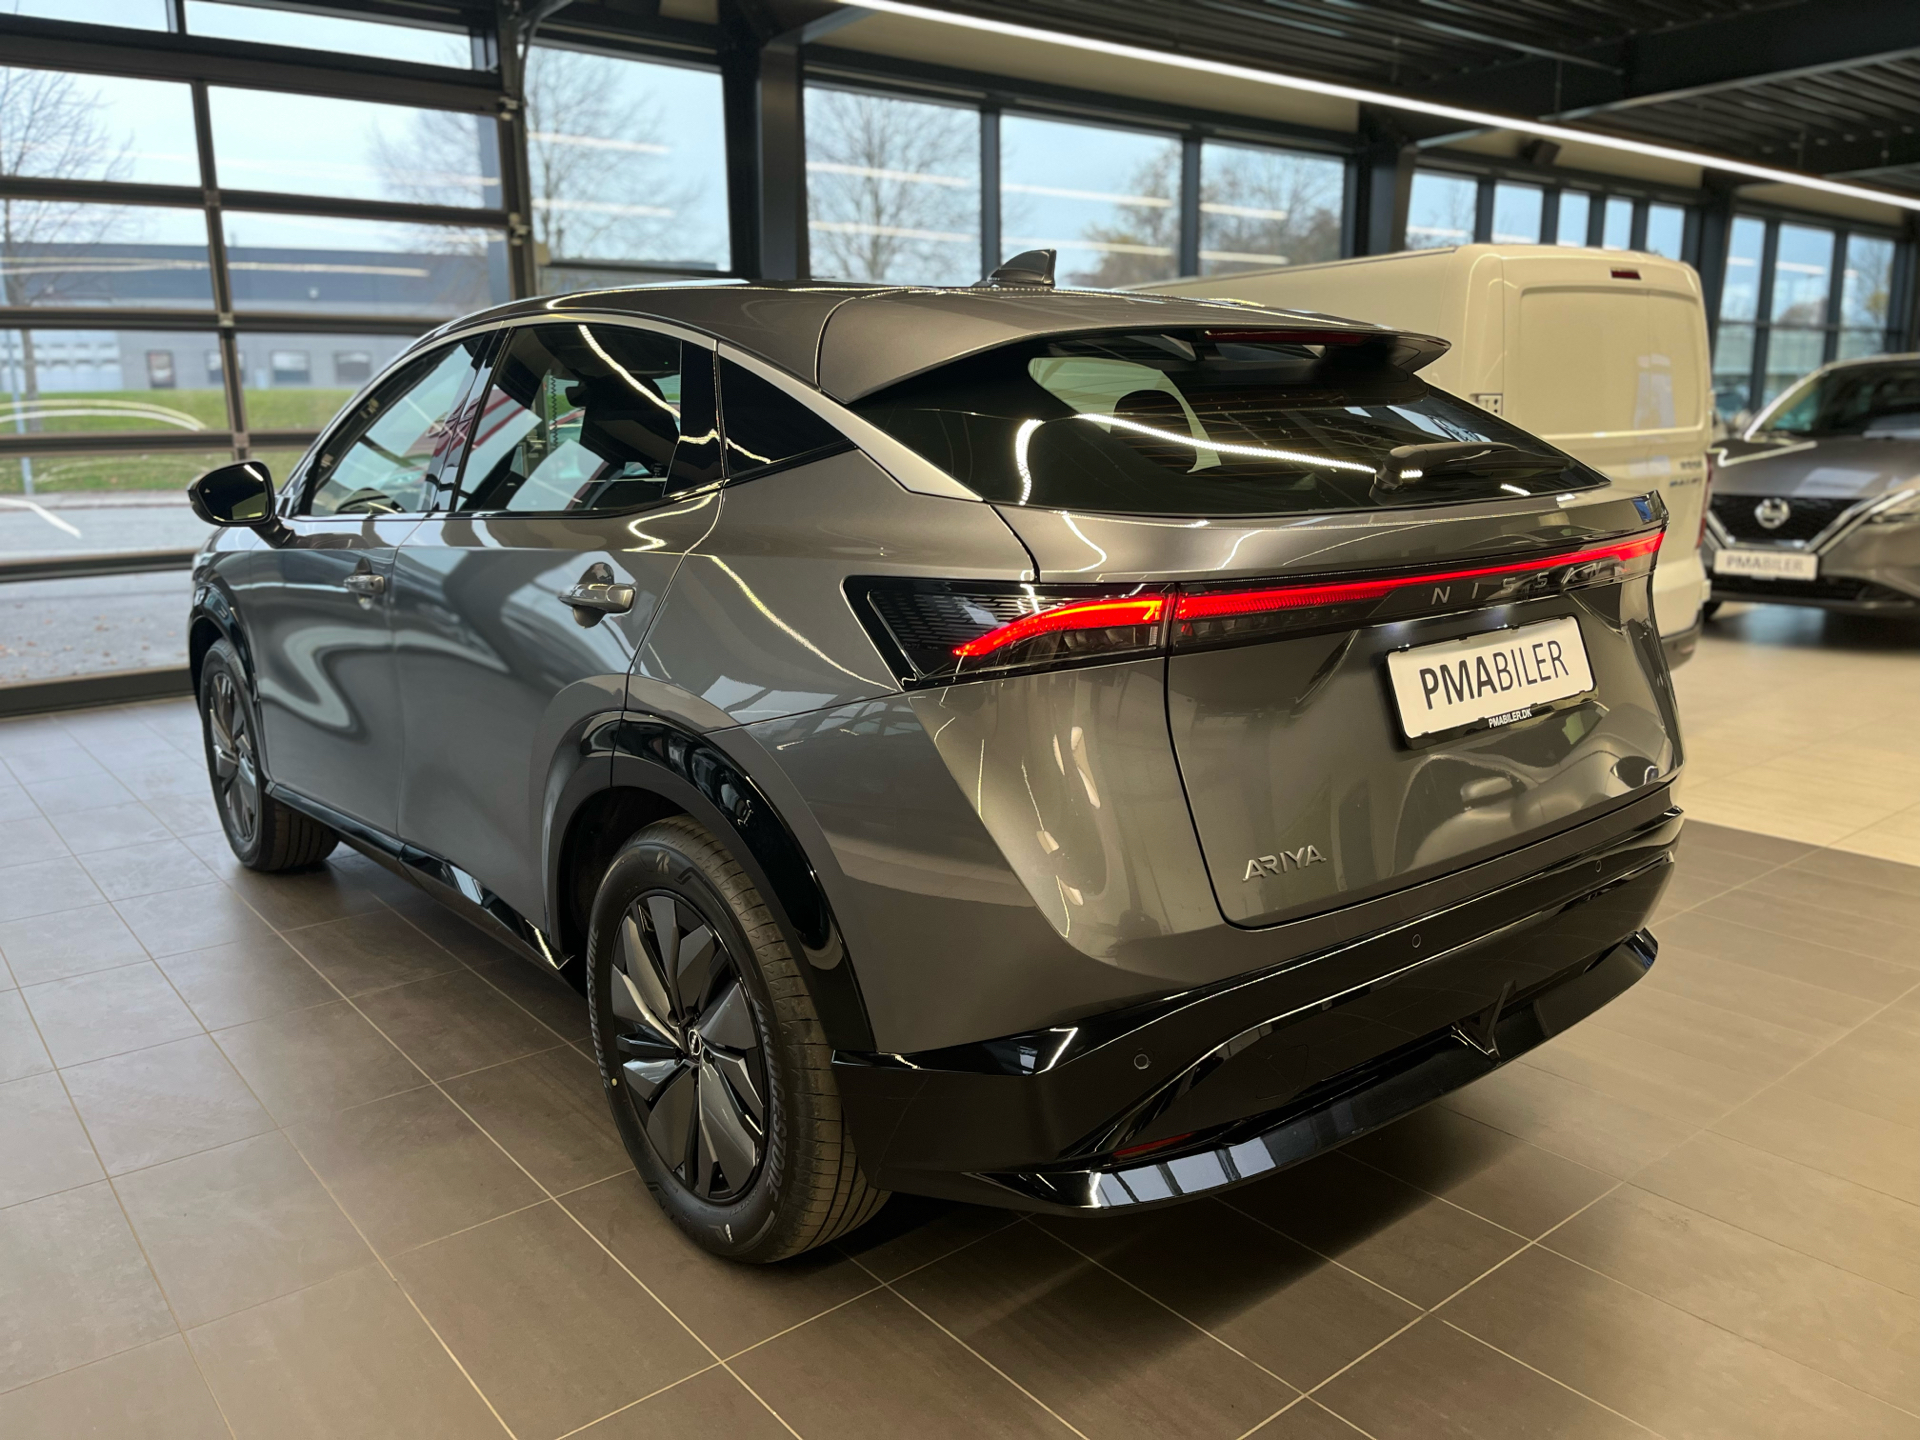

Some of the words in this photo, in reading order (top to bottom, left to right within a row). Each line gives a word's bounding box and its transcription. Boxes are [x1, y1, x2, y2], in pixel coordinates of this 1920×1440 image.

[1419, 640, 1569, 710] PMABILER
[1488, 708, 1532, 728] PMABILER.DK
[1242, 844, 1327, 882] ARIYA
[752, 998, 788, 1202] BRIDGESTONE
